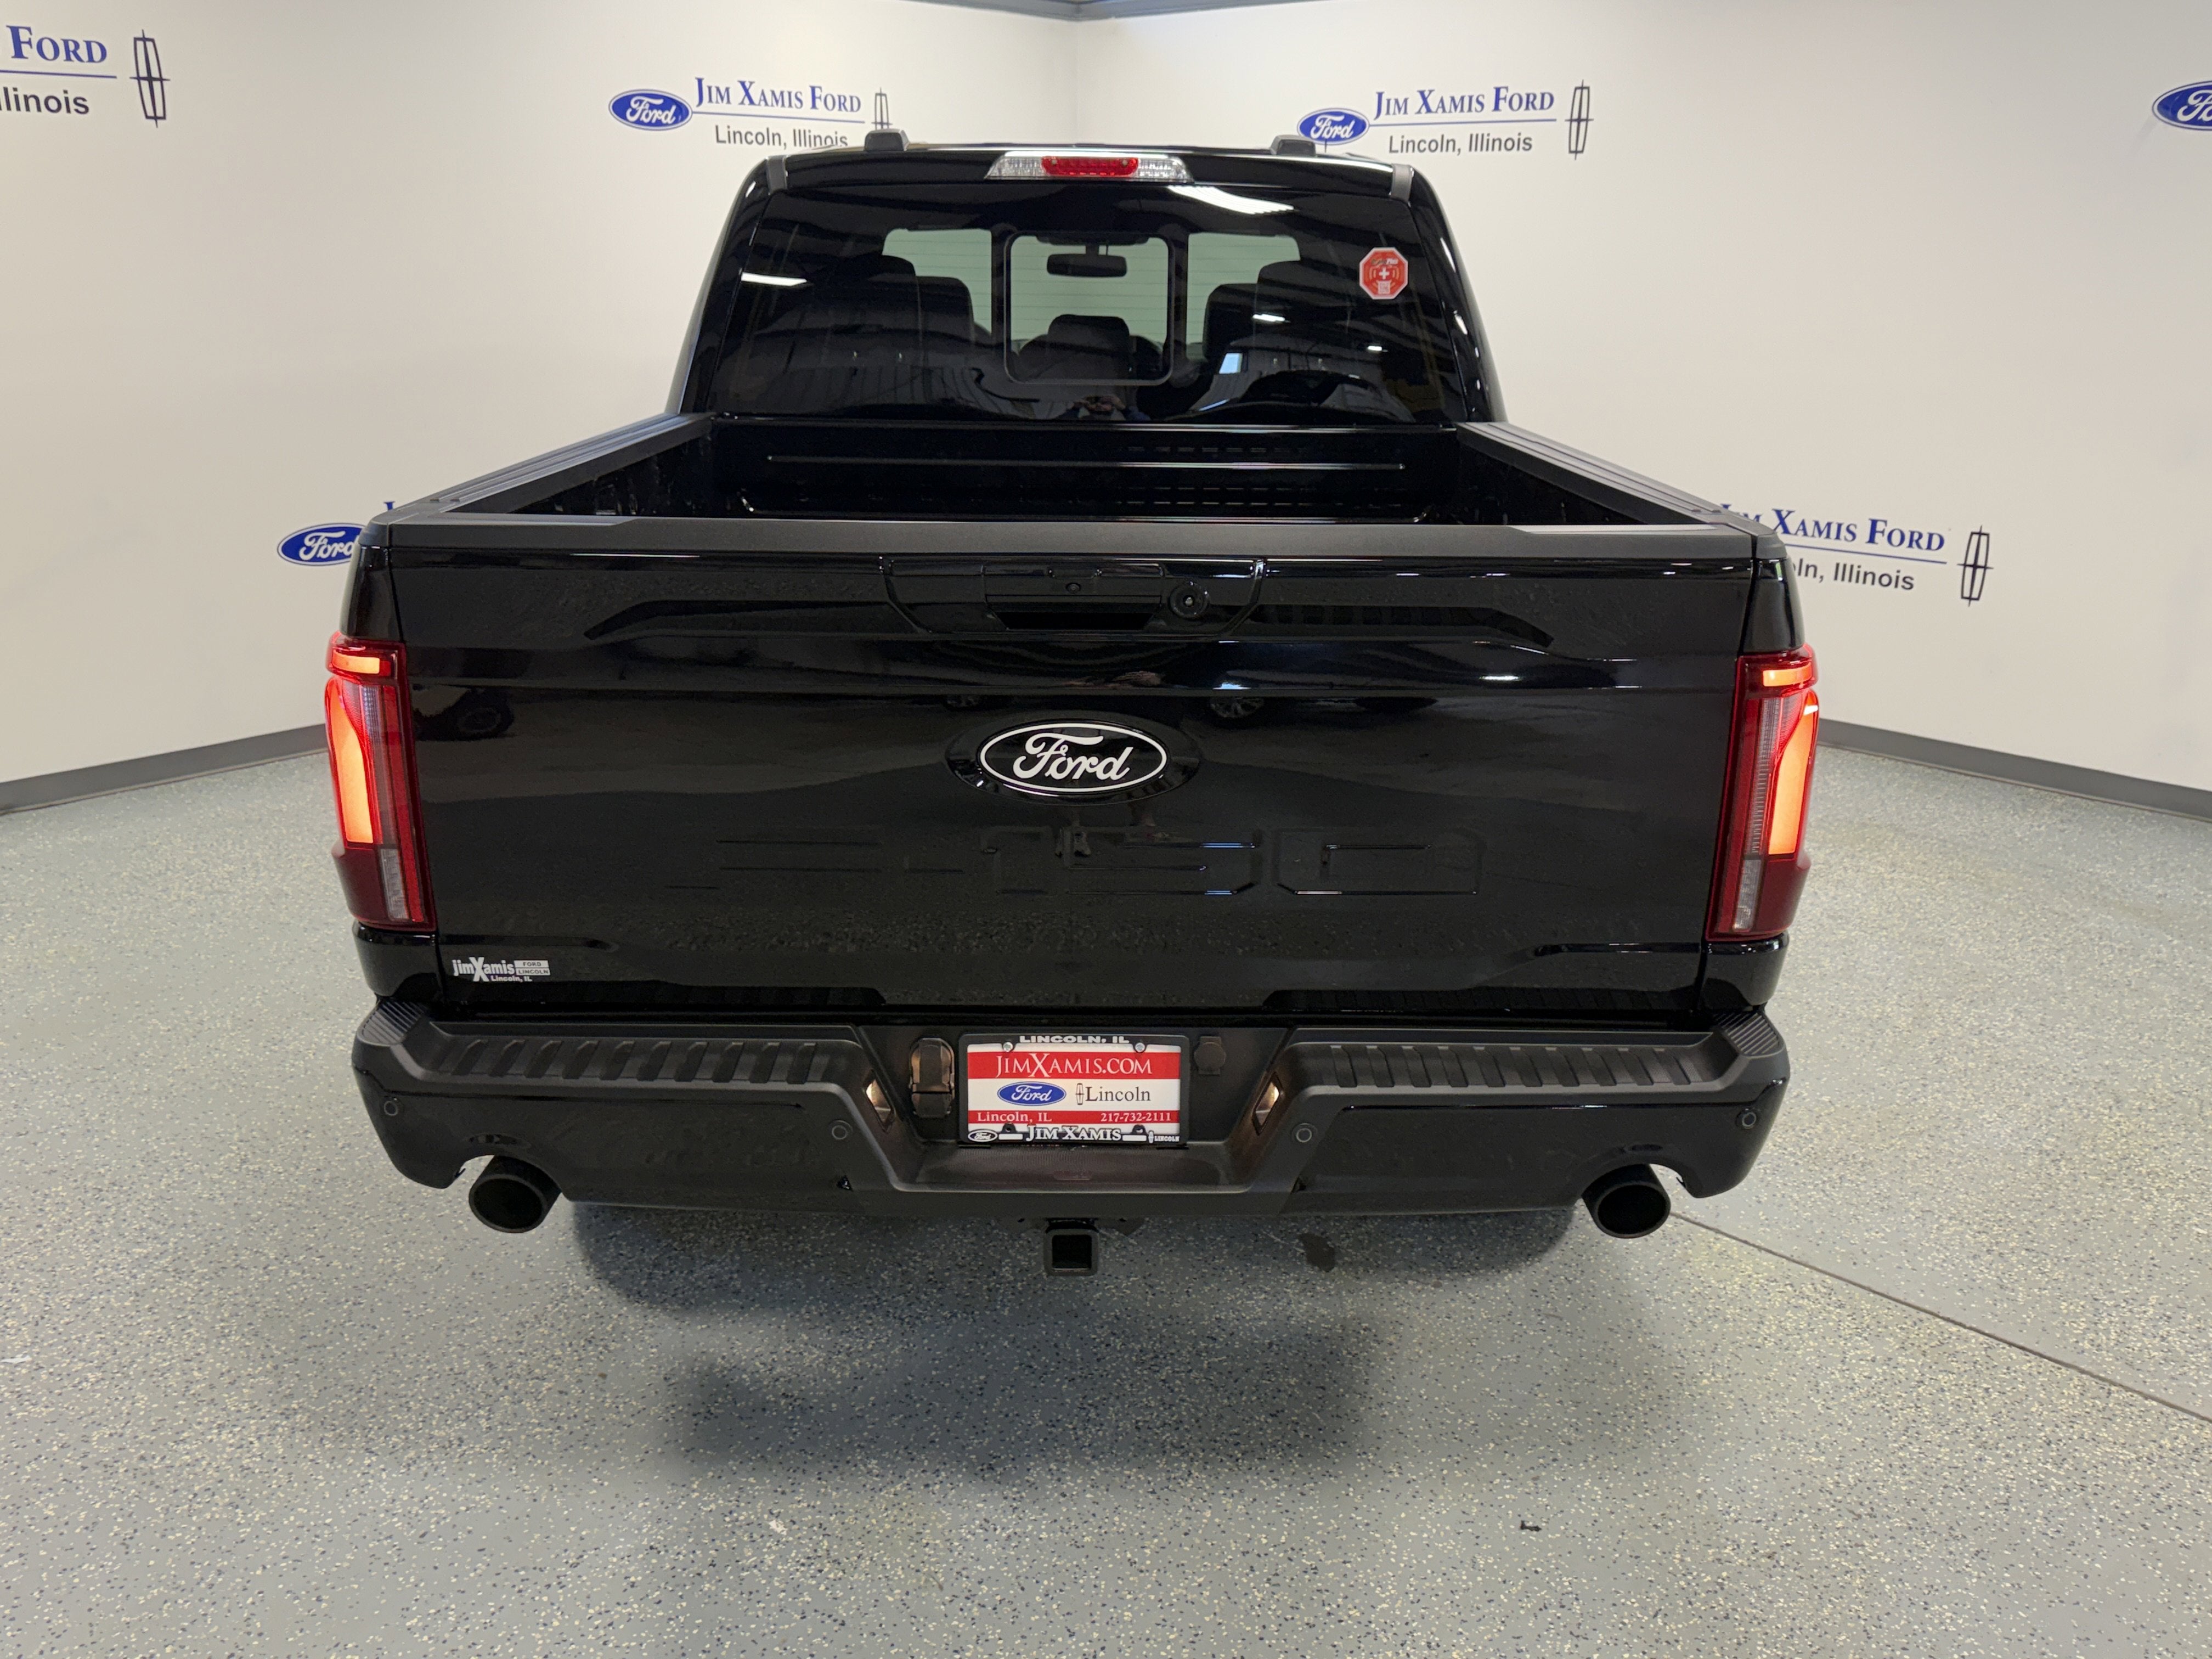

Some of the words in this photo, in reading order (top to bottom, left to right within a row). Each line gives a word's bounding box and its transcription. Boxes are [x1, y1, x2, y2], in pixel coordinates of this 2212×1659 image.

[6, 25, 107, 63] FORD
[0, 87, 89, 115] linois
[695, 77, 731, 107] JIM
[737, 80, 803, 109] XAMIS
[809, 85, 861, 112] FORD
[1374, 91, 1409, 120] JIM
[1415, 89, 1485, 115] XAMIS
[1492, 86, 1554, 112] FORD
[626, 95, 676, 125] Ford
[715, 125, 787, 150] Lincoln,
[793, 128, 848, 147] Illinois
[1310, 115, 1354, 139] Ford
[1389, 134, 1462, 156] Lincoln,
[1469, 133, 1532, 152] Illinois
[1772, 508, 1857, 542] XAMIS
[1865, 518, 1945, 551] FORD
[1833, 562, 1915, 590] Illinois
[1013, 732, 1134, 781] Ford
[995, 1053, 1152, 1079] JIMXAMIS.COM
[1011, 1084, 1052, 1102] Ford
[1085, 1086, 1151, 1102] Lincoln
[977, 1112, 1032, 1123] Lincoln,
[1038, 1113, 1052, 1122] IL
[1101, 1112, 1171, 1122] 217-732-2111
[1026, 1125, 1058, 1142] JIM
[1062, 1126, 1121, 1141] XAMIS
